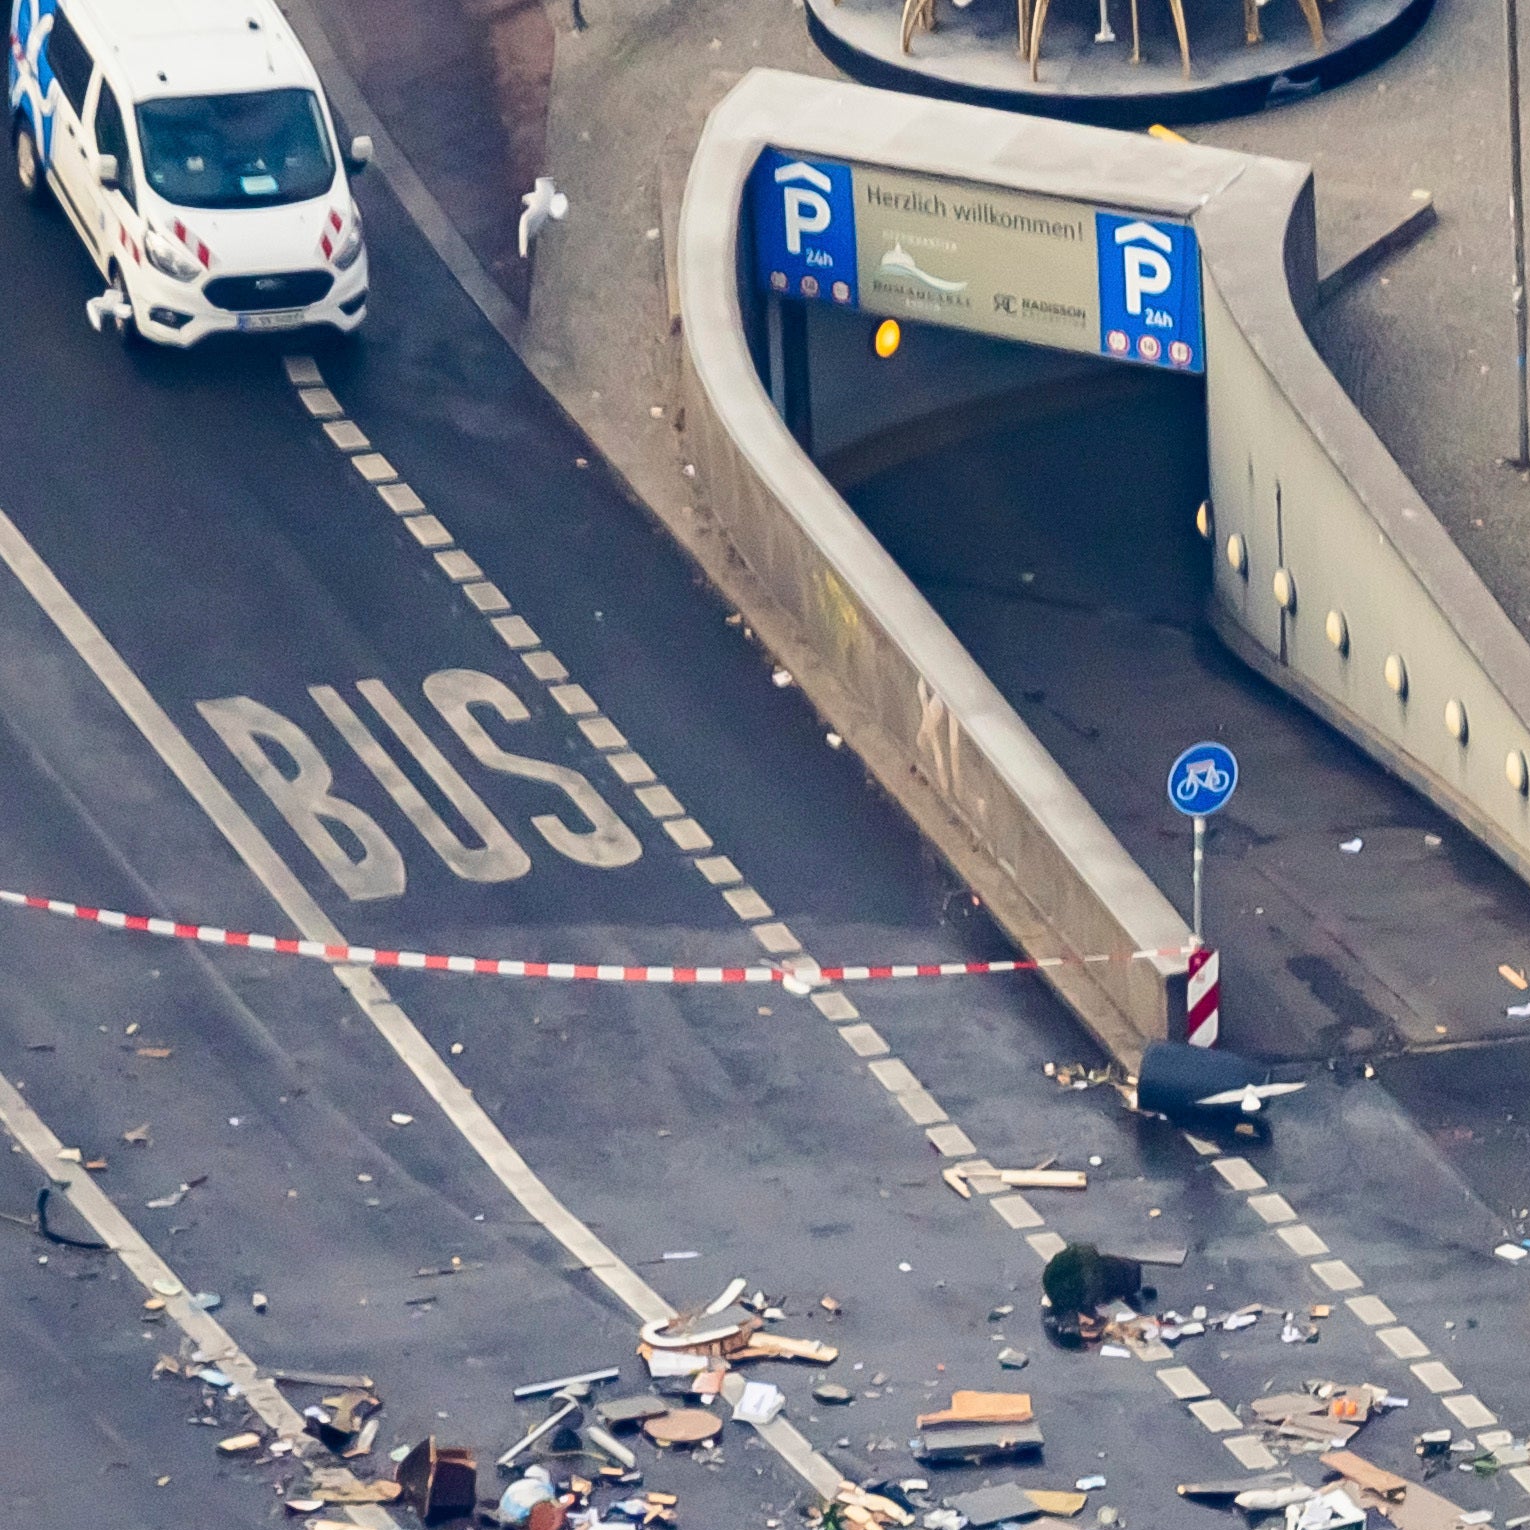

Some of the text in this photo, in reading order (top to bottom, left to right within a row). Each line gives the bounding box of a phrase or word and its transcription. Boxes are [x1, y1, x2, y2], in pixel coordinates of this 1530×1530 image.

[784, 186, 831, 254] P
[867, 183, 947, 218] Herzlich
[953, 202, 1084, 242] willkommen!
[805, 247, 834, 268] 24h
[1124, 245, 1171, 315] P
[1144, 307, 1174, 329] 24h
[196, 668, 643, 901] BUS
